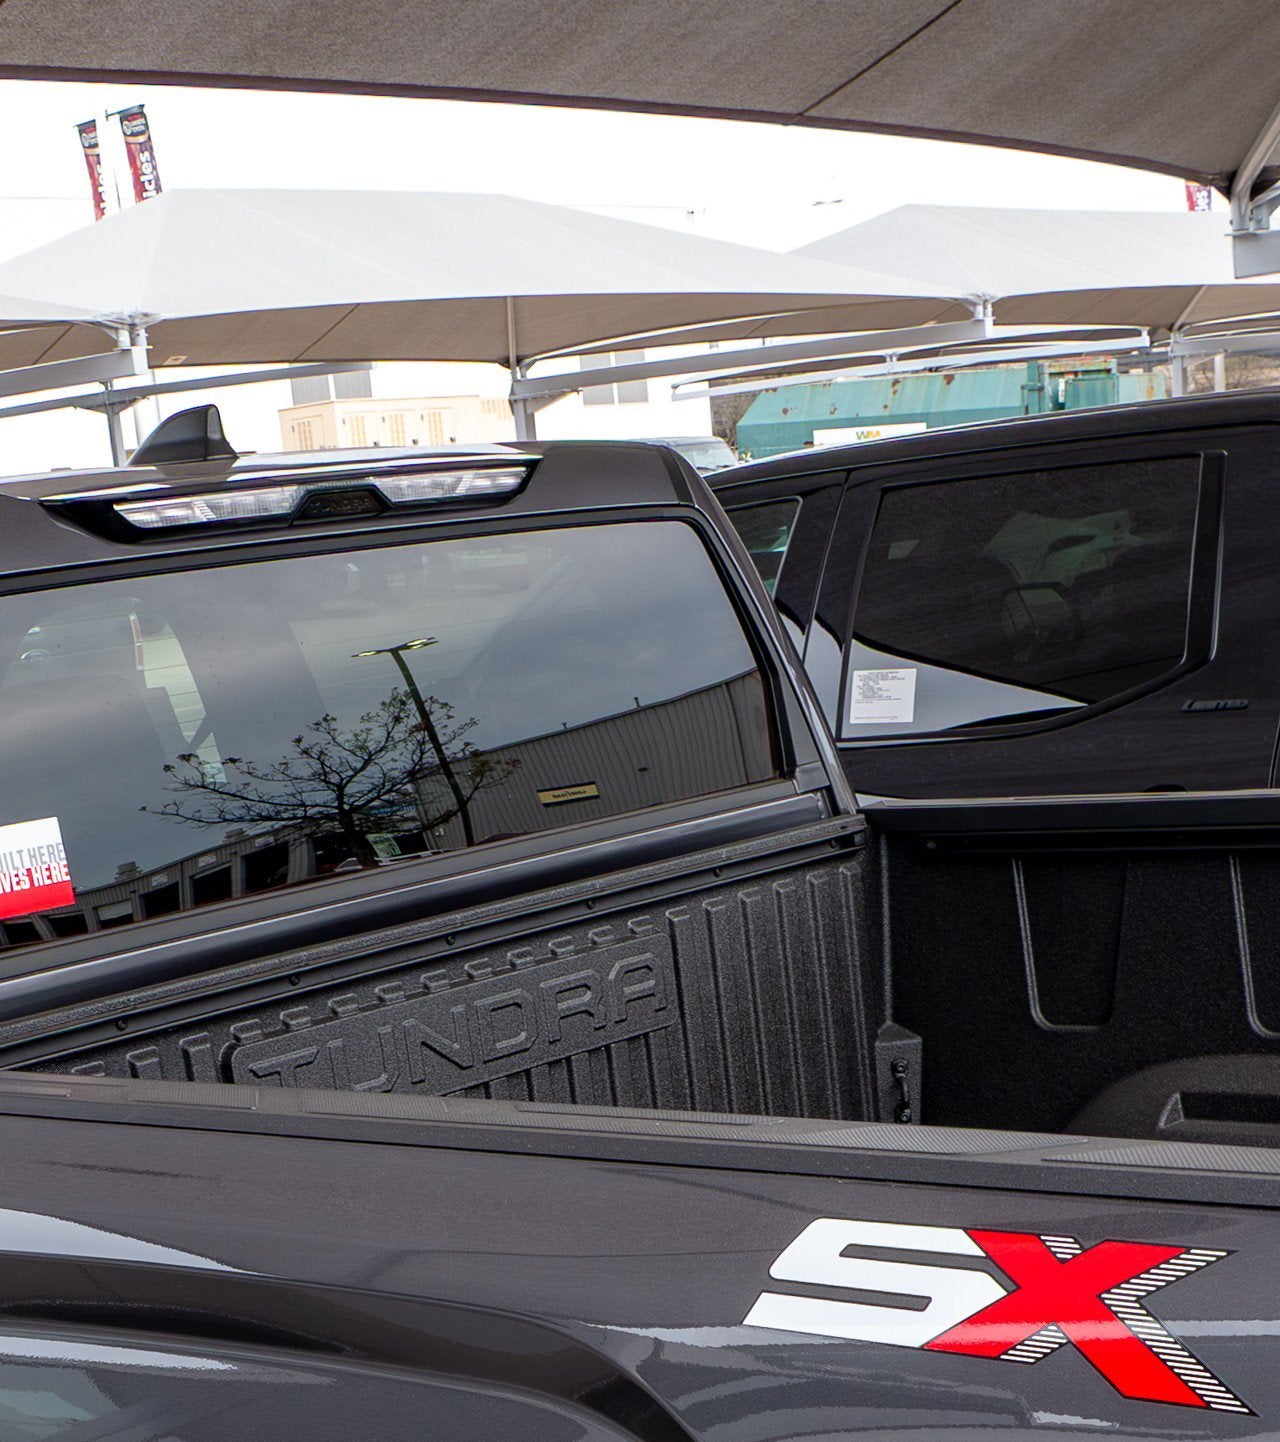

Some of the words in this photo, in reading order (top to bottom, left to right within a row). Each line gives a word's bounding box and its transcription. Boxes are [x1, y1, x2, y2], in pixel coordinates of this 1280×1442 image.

[27, 843, 66, 867] HERE
[31, 862, 71, 887] HERE
[249, 951, 668, 1093] TUNDRA
